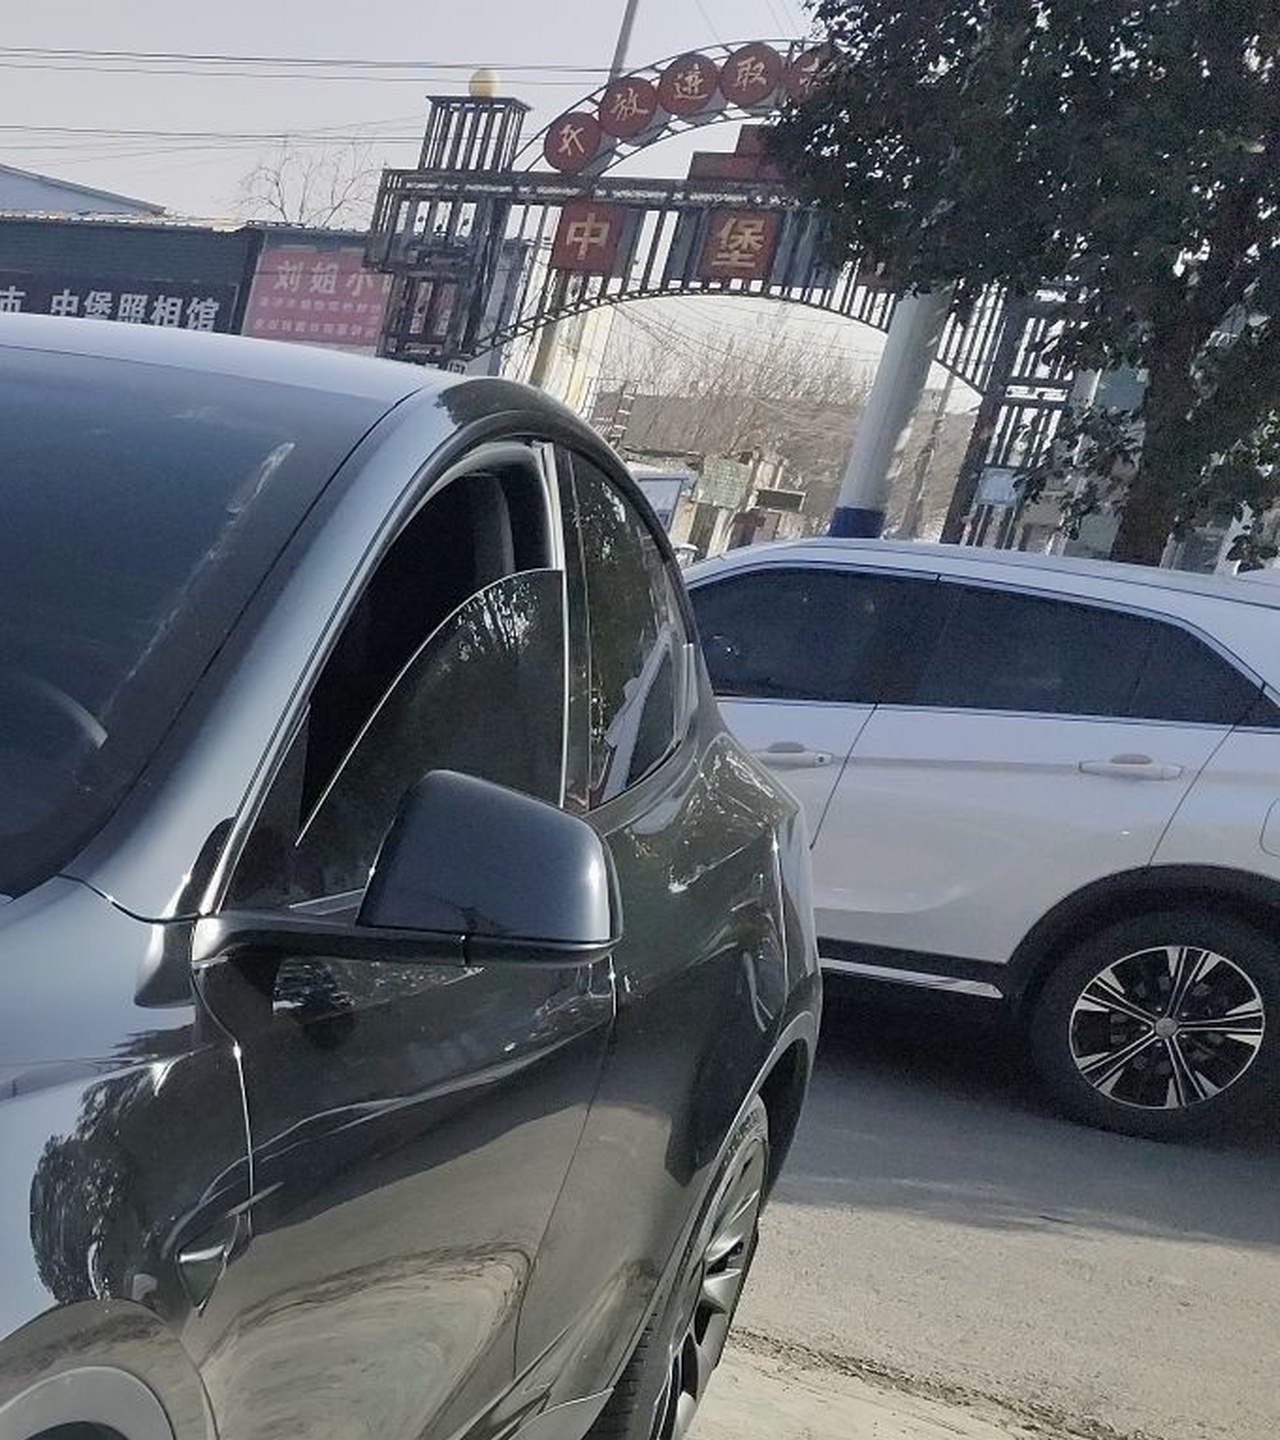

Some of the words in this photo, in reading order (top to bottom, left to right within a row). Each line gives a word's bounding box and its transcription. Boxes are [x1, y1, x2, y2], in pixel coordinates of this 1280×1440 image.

[566, 212, 765, 268] 中堡
[50, 289, 220, 332] 中堡照相馆
